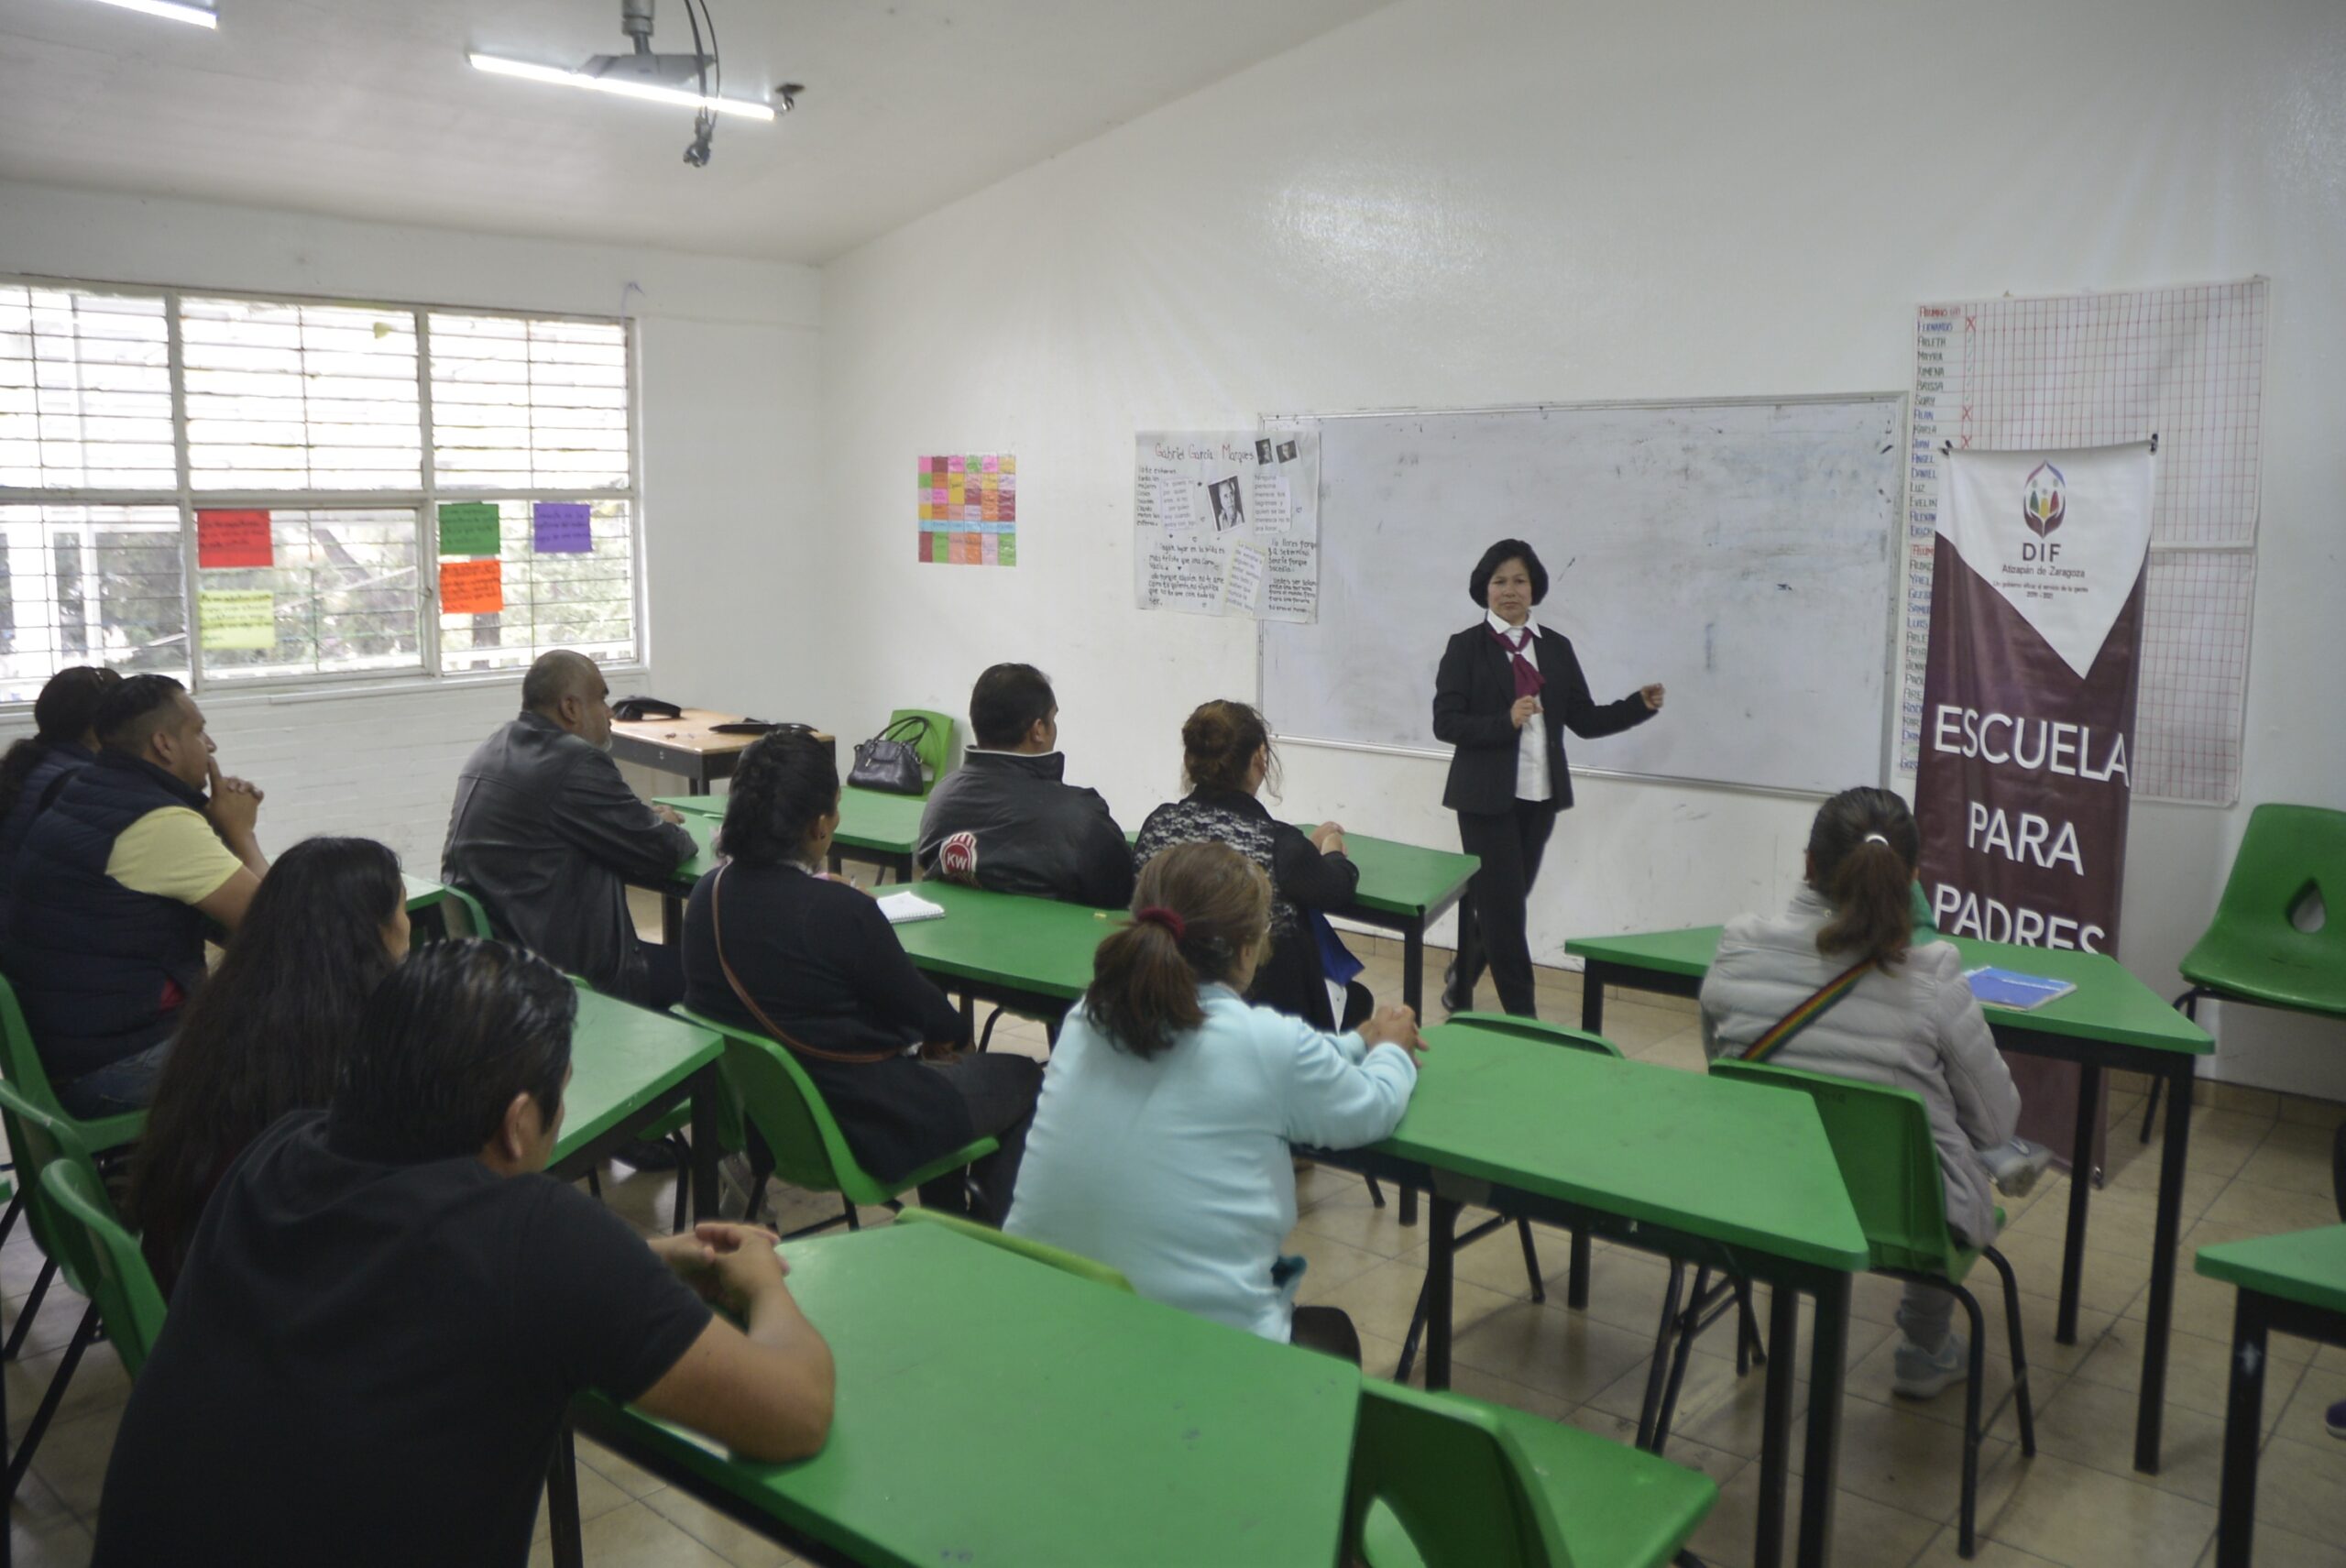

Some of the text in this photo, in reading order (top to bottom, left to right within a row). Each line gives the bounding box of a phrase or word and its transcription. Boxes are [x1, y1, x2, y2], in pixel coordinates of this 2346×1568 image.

[1155, 442, 1184, 461] Gabriel
[1911, 468, 1936, 478] DANIEL
[1910, 482, 1926, 493] LUZ
[2022, 543, 2061, 562] DIF
[2001, 565, 2086, 580] Atizapán de Zaragoza
[1934, 704, 2131, 787] ESCUELA
[1968, 800, 2085, 876] PARA
[947, 852, 968, 871] KW
